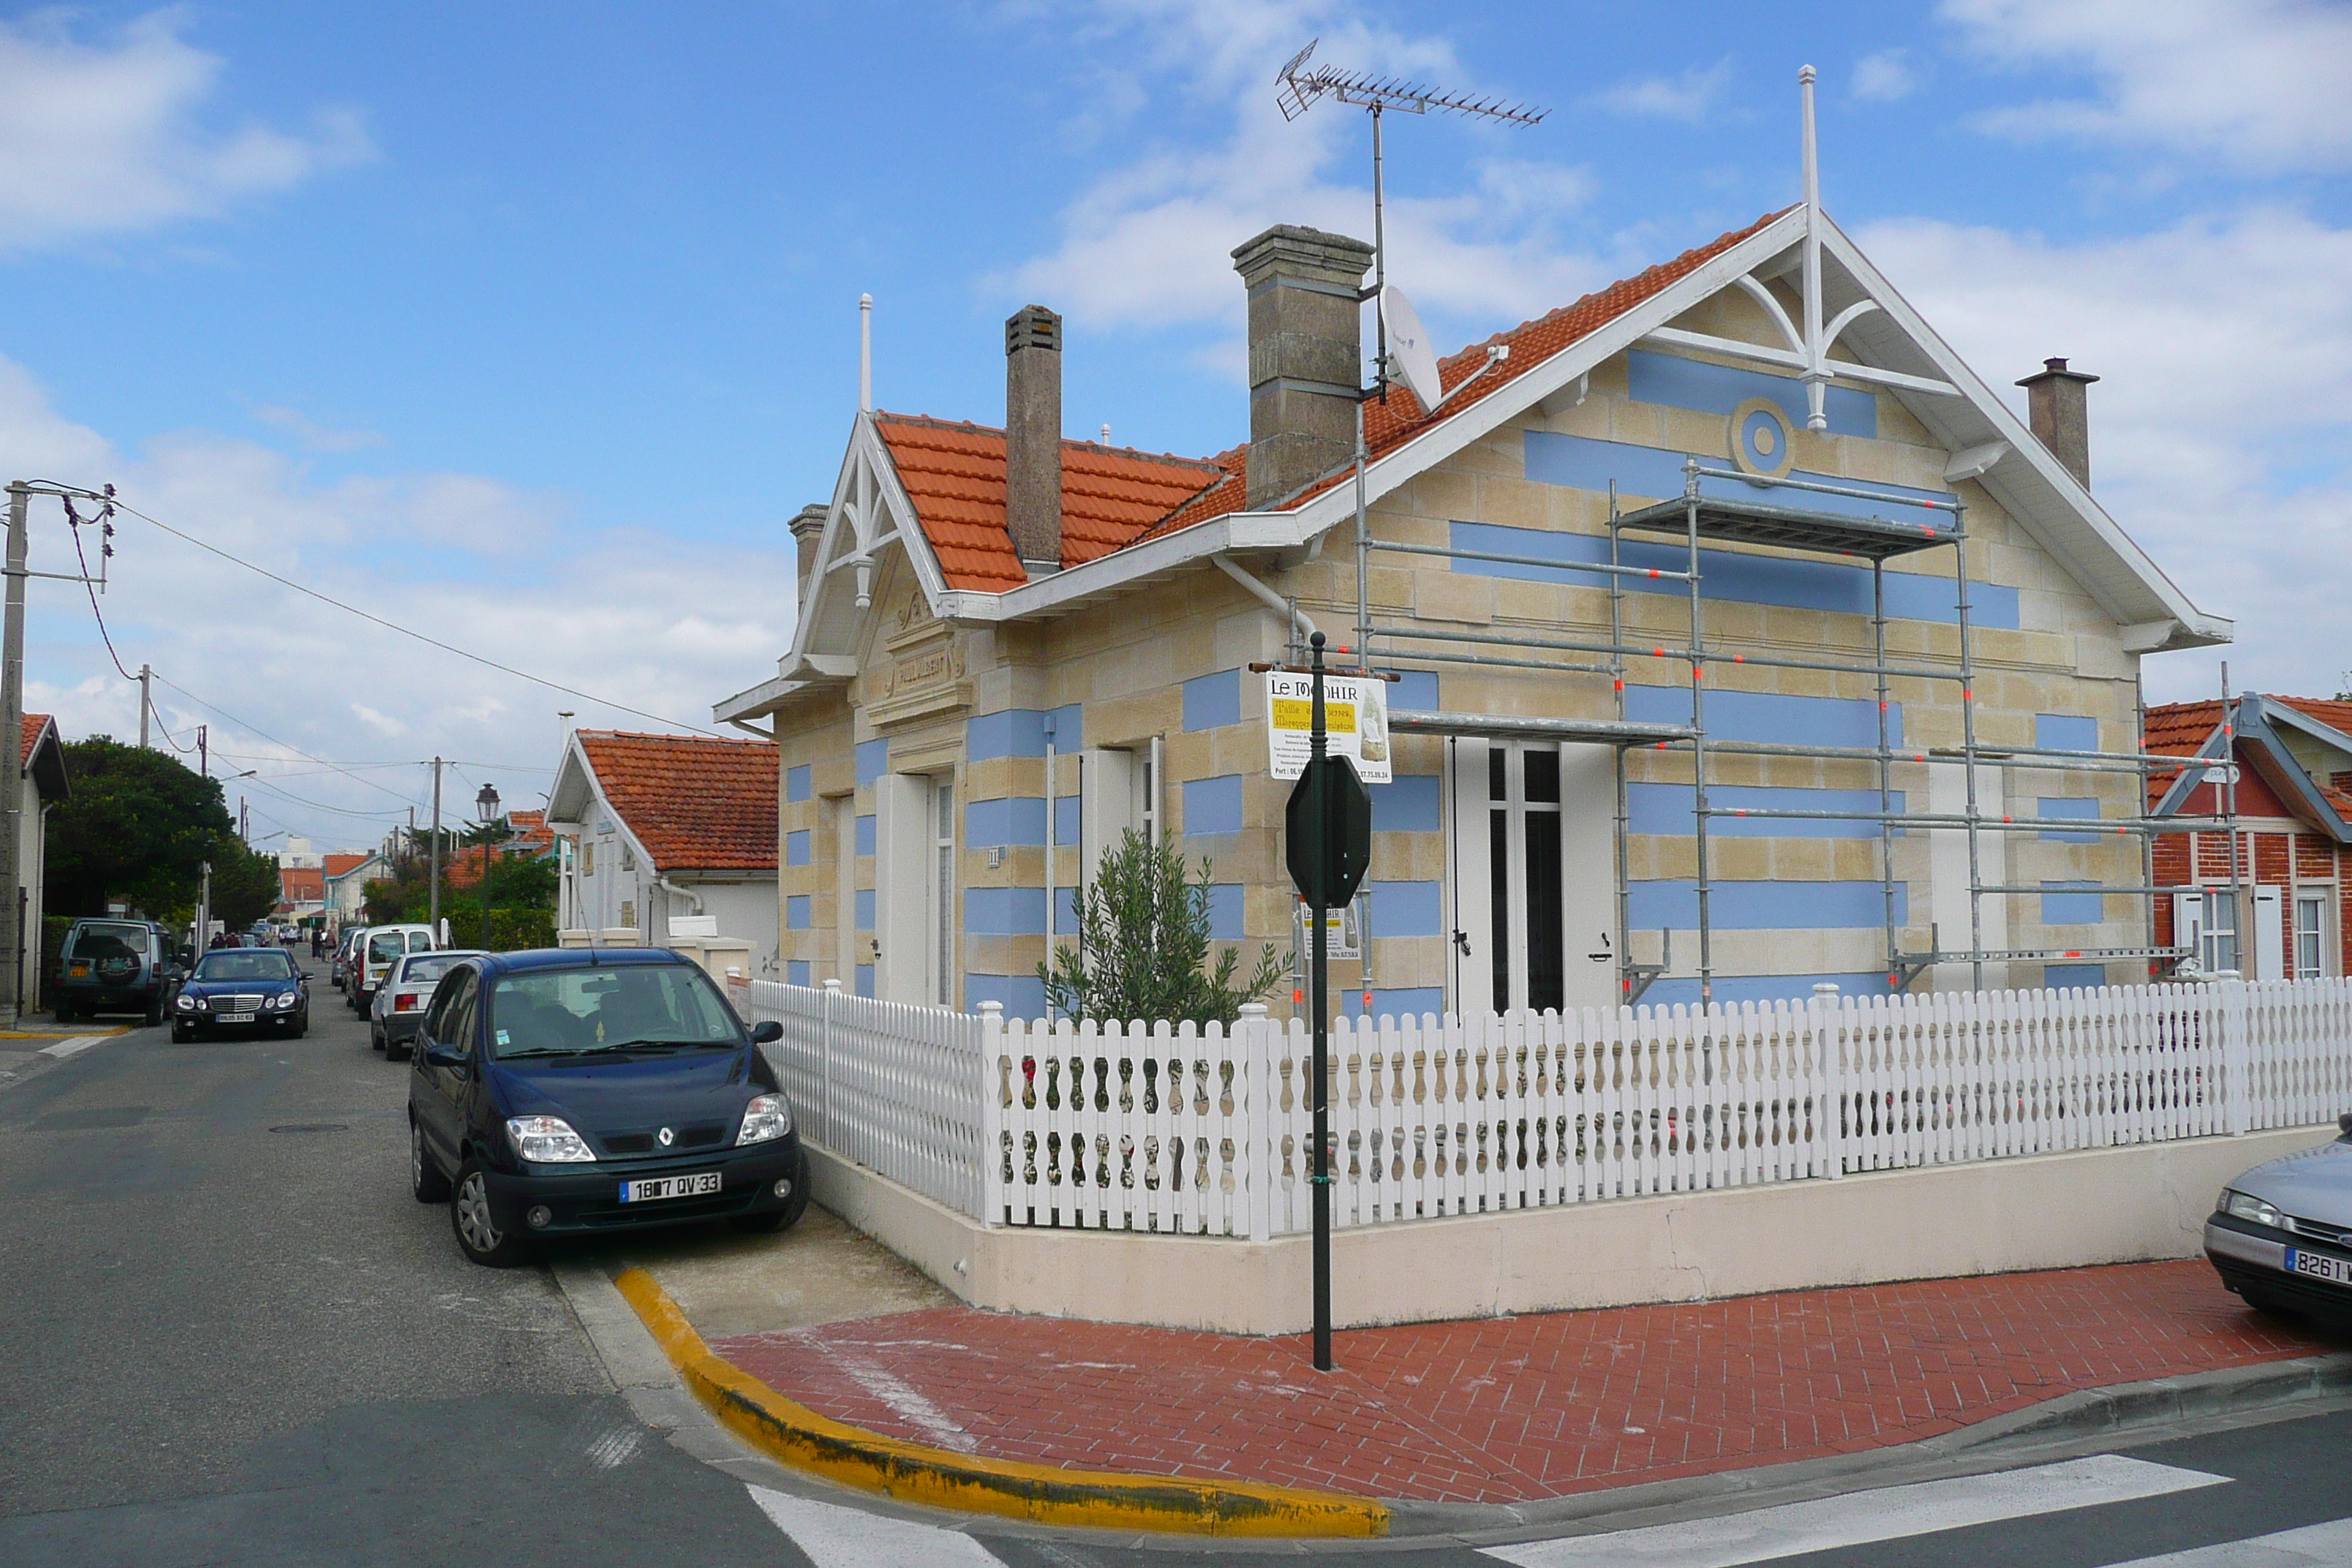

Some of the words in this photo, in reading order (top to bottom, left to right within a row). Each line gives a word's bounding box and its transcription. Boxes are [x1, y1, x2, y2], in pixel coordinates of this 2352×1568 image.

[1271, 679, 1290, 696] Le
[990, 851, 996, 863] 11
[636, 1180, 671, 1199] 187
[677, 1176, 696, 1194] QV
[700, 1175, 718, 1191] 33
[2298, 1254, 2340, 1280] 8261
